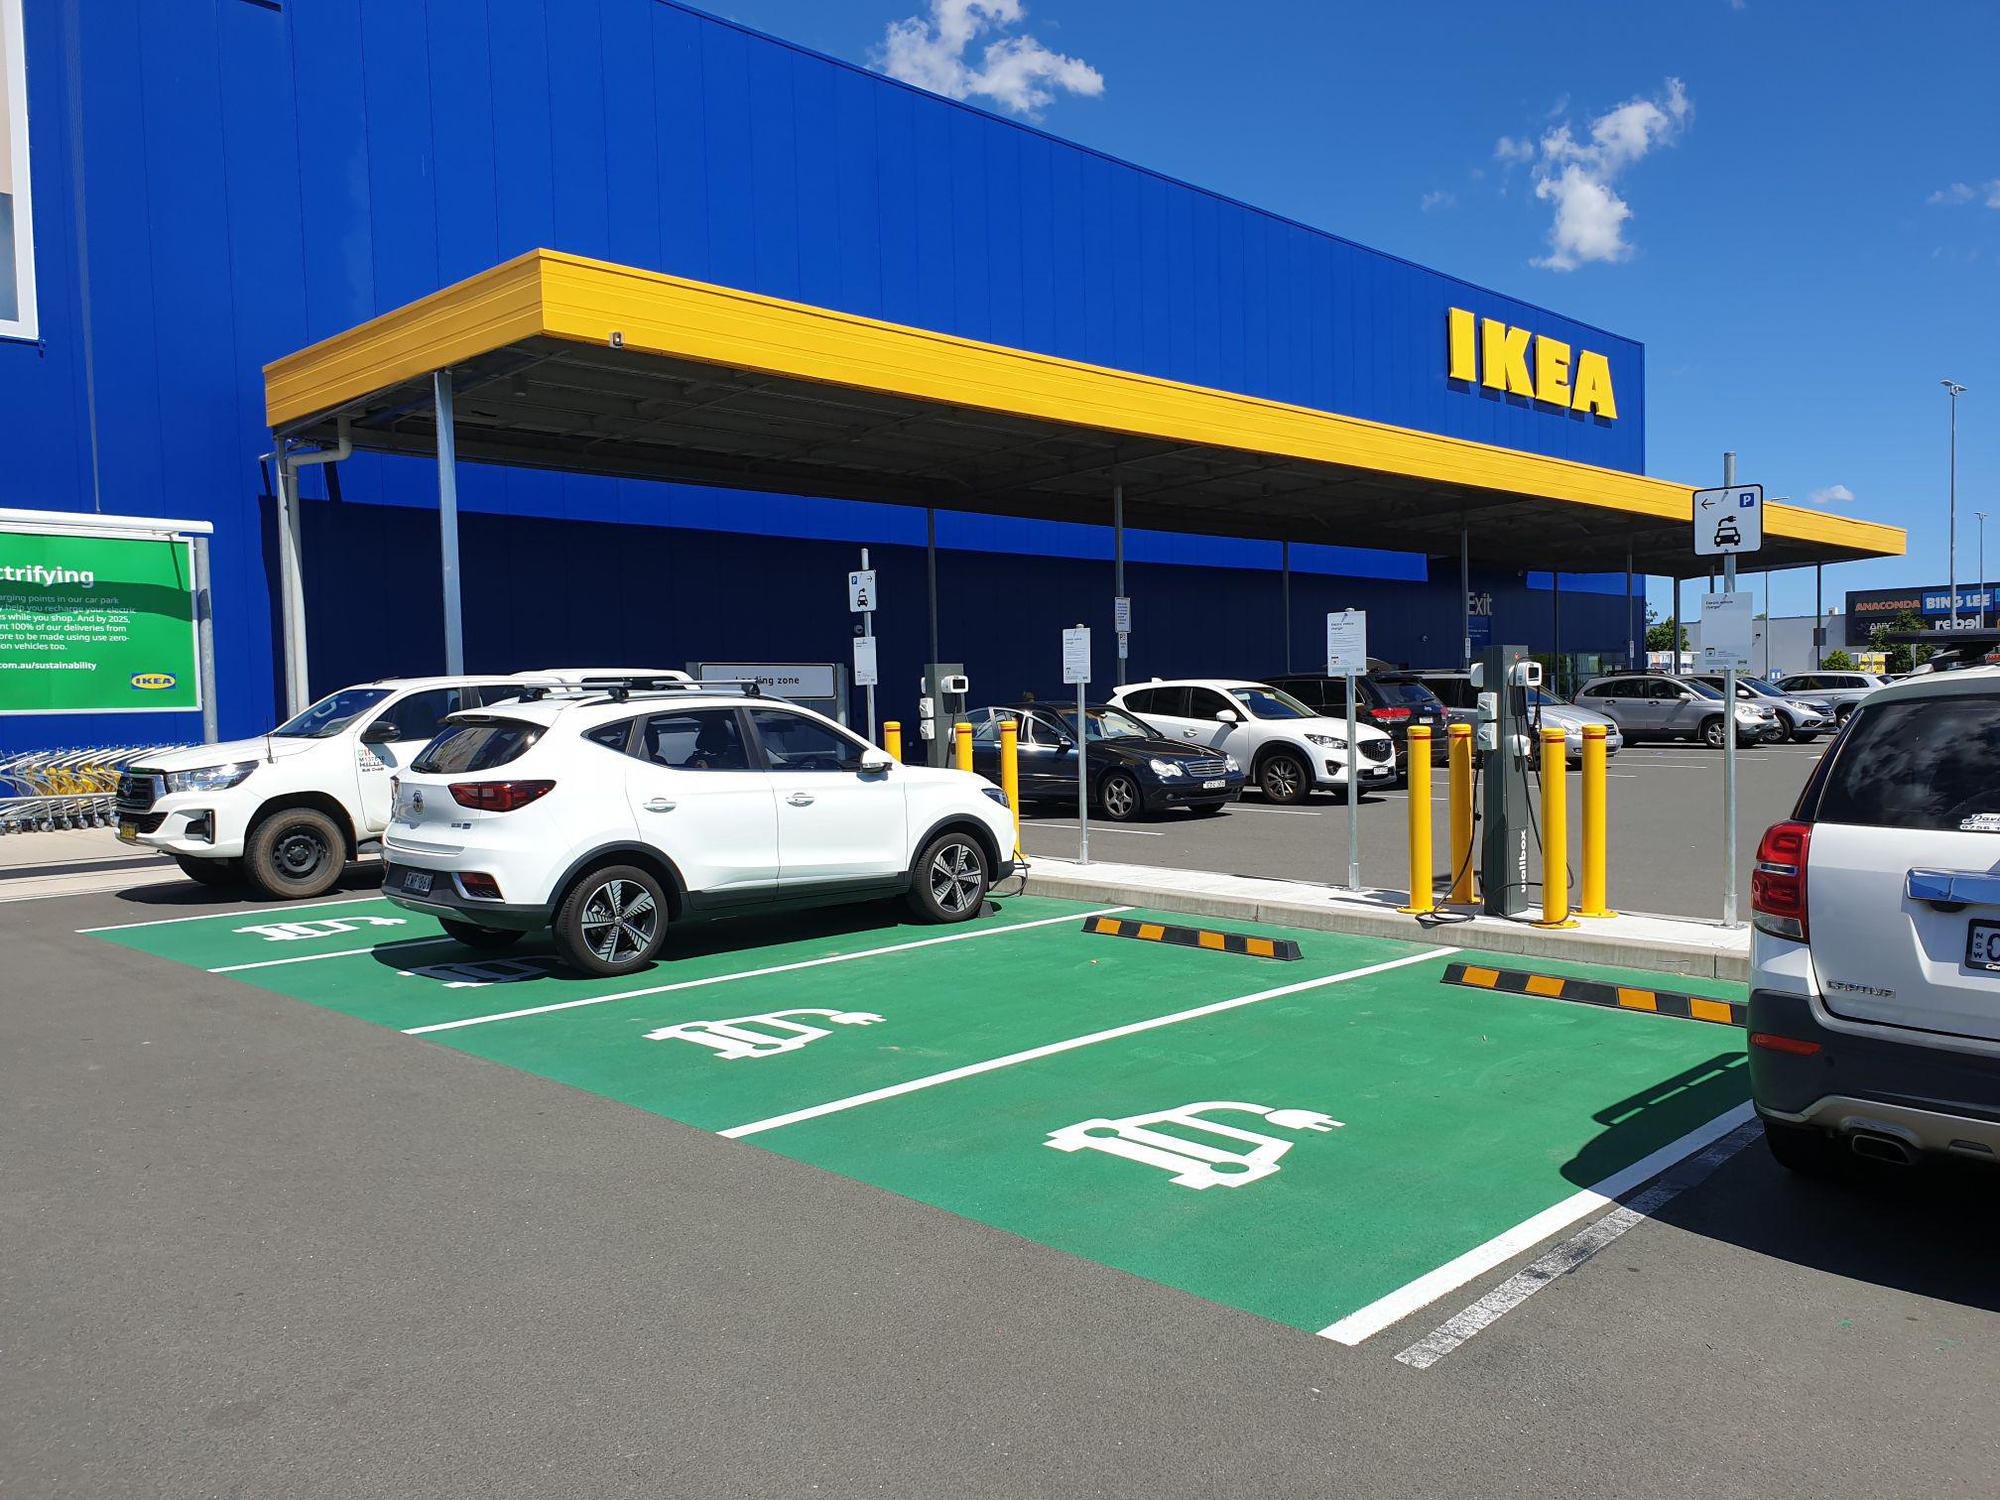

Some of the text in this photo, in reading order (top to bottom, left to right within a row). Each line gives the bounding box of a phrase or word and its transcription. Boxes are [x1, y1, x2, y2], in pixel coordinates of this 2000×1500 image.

[1449, 307, 1617, 419] IKEA
[28, 595, 55, 603] points
[1467, 592, 1492, 615] Exit
[1926, 594, 1990, 609] BING LEE
[6, 604, 24, 612] help
[26, 605, 43, 613] you
[45, 604, 83, 614] recharge
[85, 606, 104, 614] your
[1855, 600, 1920, 611] ANACONDA
[8, 613, 32, 621] while
[33, 614, 48, 622] you
[51, 614, 76, 623] shop.
[97, 615, 107, 623] by
[12, 623, 34, 631] 100%
[64, 624, 105, 632] deliveries
[67, 634, 91, 643] using
[14, 642, 49, 650] vehicles
[135, 677, 172, 685] IKEA
[1519, 830, 1527, 893] wallbox
